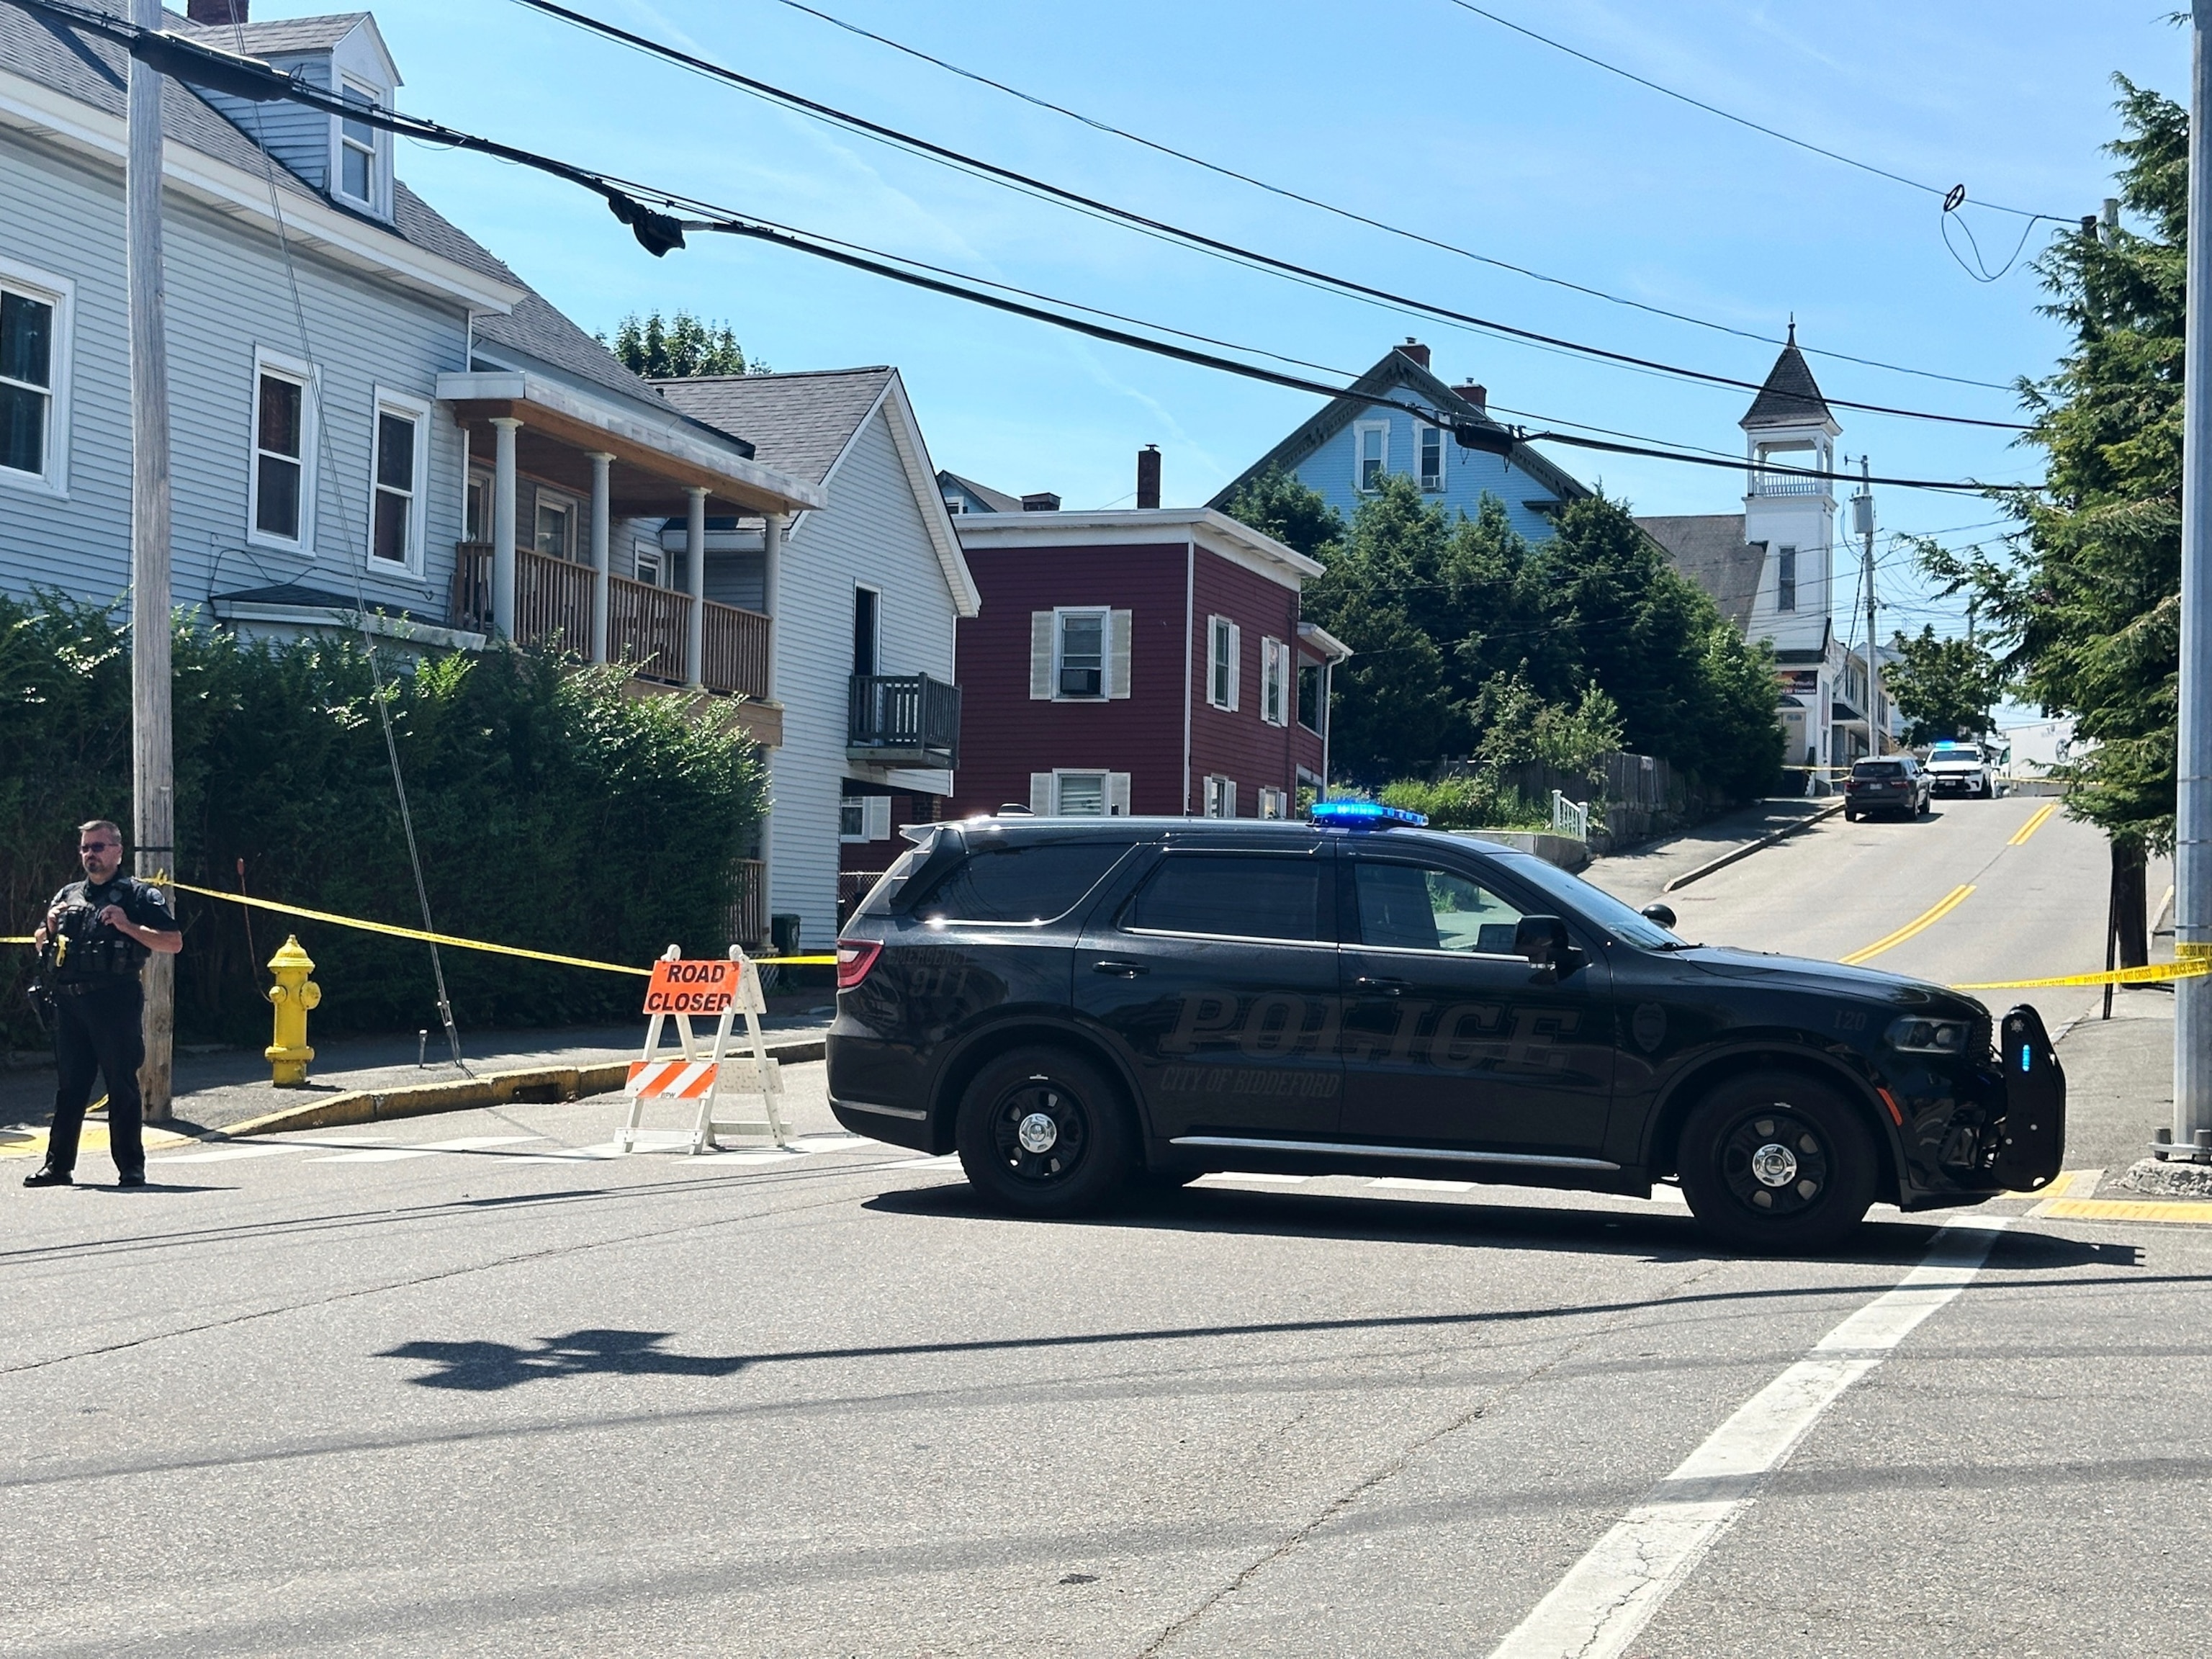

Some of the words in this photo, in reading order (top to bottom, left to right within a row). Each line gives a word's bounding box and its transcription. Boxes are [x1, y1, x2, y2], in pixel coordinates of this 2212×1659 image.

[667, 965, 725, 983] ROAD
[908, 967, 969, 997] 911
[2134, 968, 2152, 980] CROSS
[648, 992, 732, 1011] CLOSED
[1833, 1010, 1867, 1031] 120
[1158, 990, 1583, 1077] POLICE
[1160, 1066, 1207, 1092] CITY
[1205, 1069, 1233, 1092] OF
[1232, 1070, 1340, 1098] BIDDEFORD
